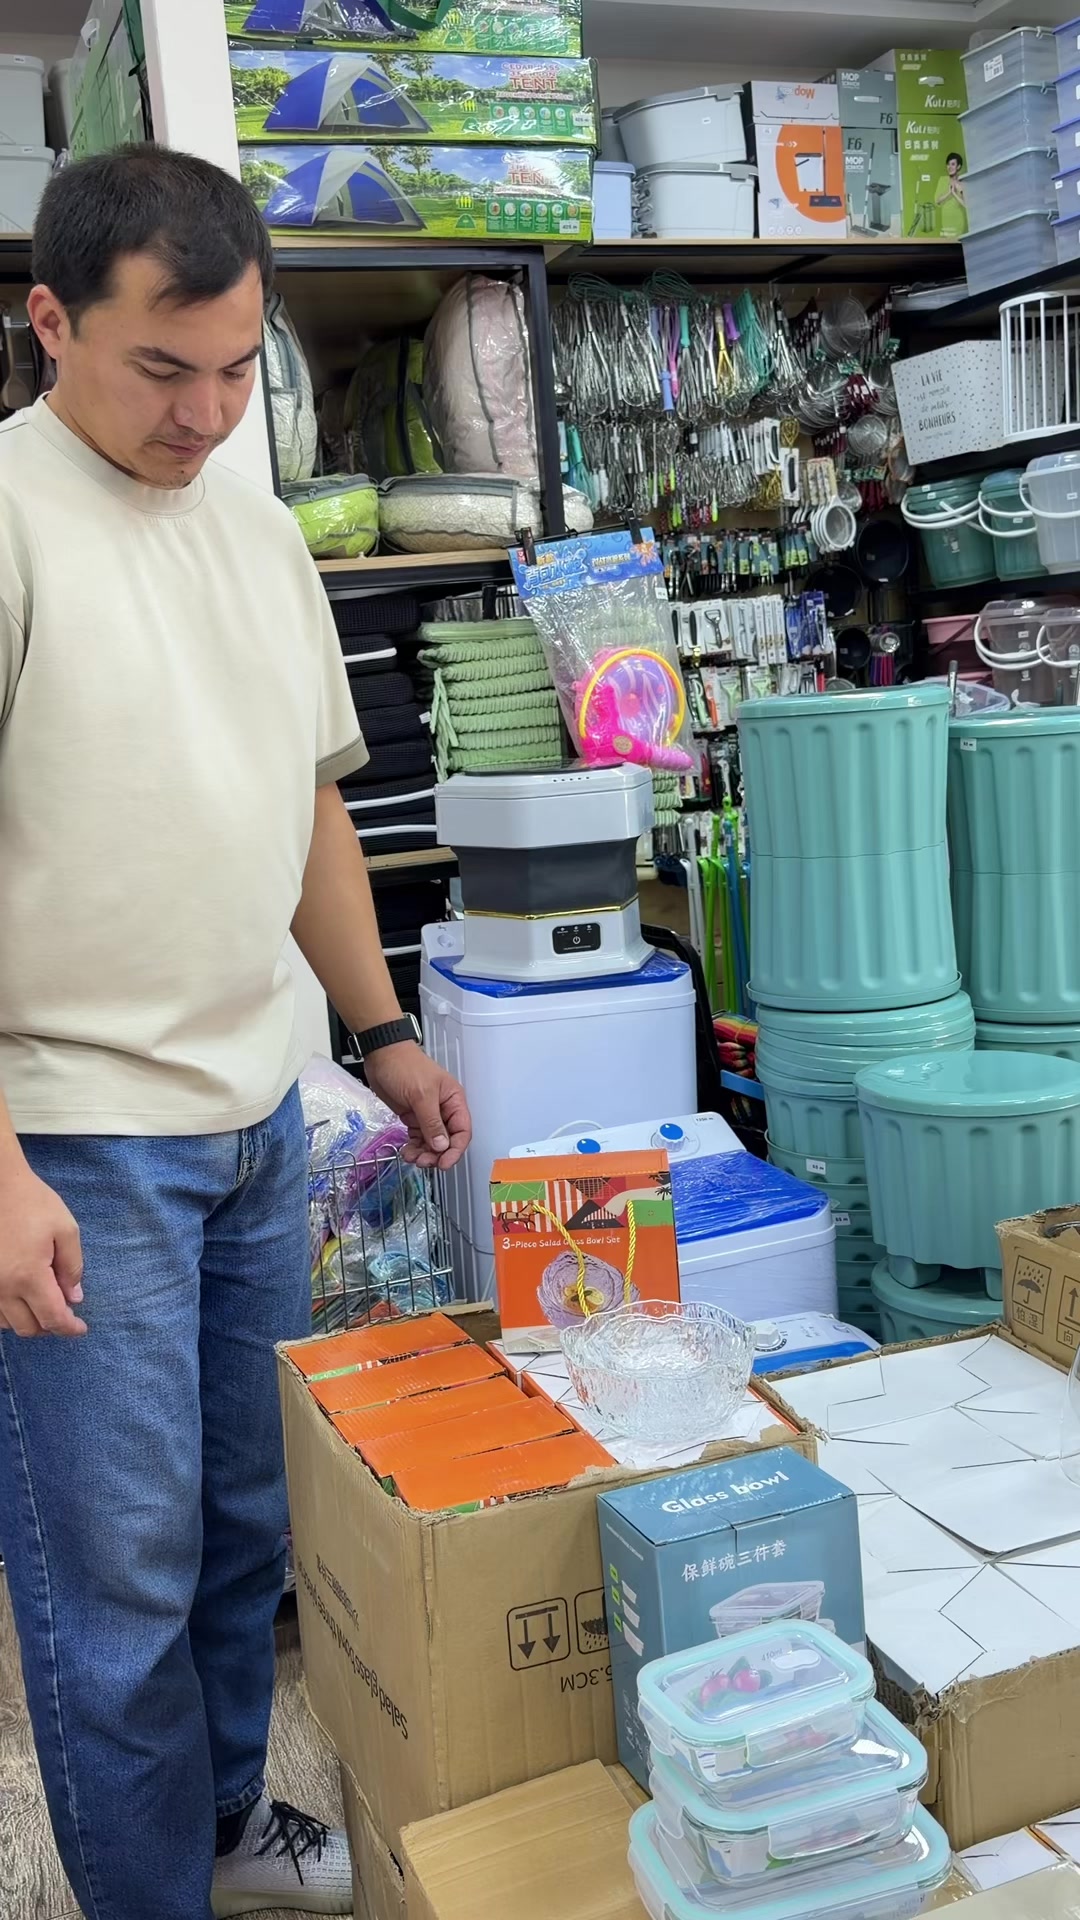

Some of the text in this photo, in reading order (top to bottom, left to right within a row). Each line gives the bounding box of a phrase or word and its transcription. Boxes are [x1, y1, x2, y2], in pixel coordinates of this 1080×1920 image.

[841, 72, 860, 81] MOP
[508, 77, 557, 91] TENT
[794, 84, 815, 99] Mop
[879, 112, 893, 125] F6
[847, 137, 863, 151] F6
[845, 156, 864, 165] MOP
[508, 172, 546, 185] TEN
[919, 411, 956, 431] BONHEURS
[502, 1236, 621, 1250] 3-Piece Salad Gss Bowl Set
[661, 1491, 730, 1513] Glass
[729, 1470, 790, 1496] bowl
[681, 1539, 787, 1583] 保鲜碗三件套
[354, 1655, 379, 1698] glass
[378, 1685, 409, 1741] Salad
